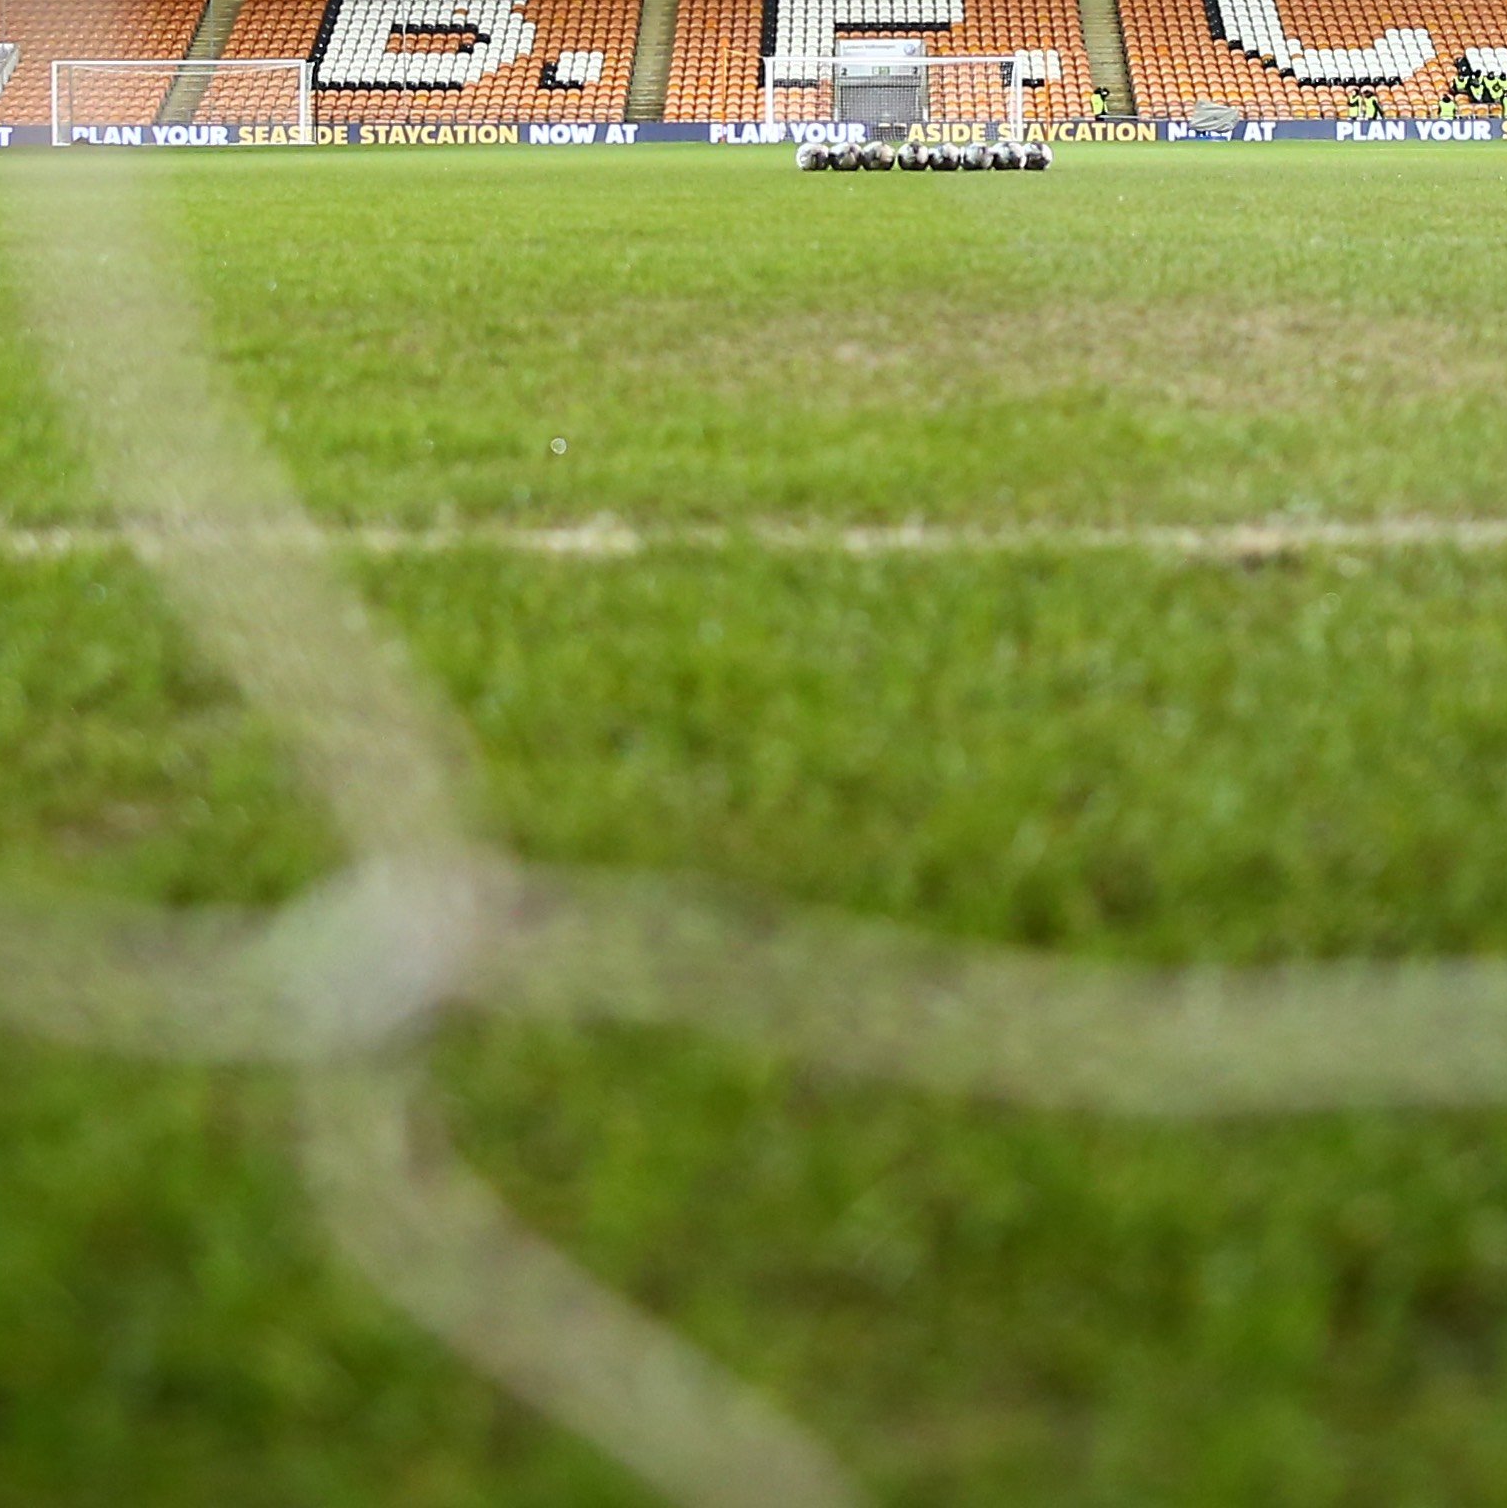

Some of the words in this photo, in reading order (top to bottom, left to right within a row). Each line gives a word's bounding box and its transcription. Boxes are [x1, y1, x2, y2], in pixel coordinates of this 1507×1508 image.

[73, 126, 142, 145] PLAN
[152, 125, 229, 145] YOUR
[238, 125, 349, 145] SEASDE
[359, 124, 519, 145] STAYCATION
[529, 124, 596, 144] NOW
[604, 124, 639, 144] AT
[792, 123, 866, 143] YOUR
[1243, 122, 1277, 142] AT
[1336, 120, 1405, 141] PLAN
[1415, 120, 1492, 140] YOUR
